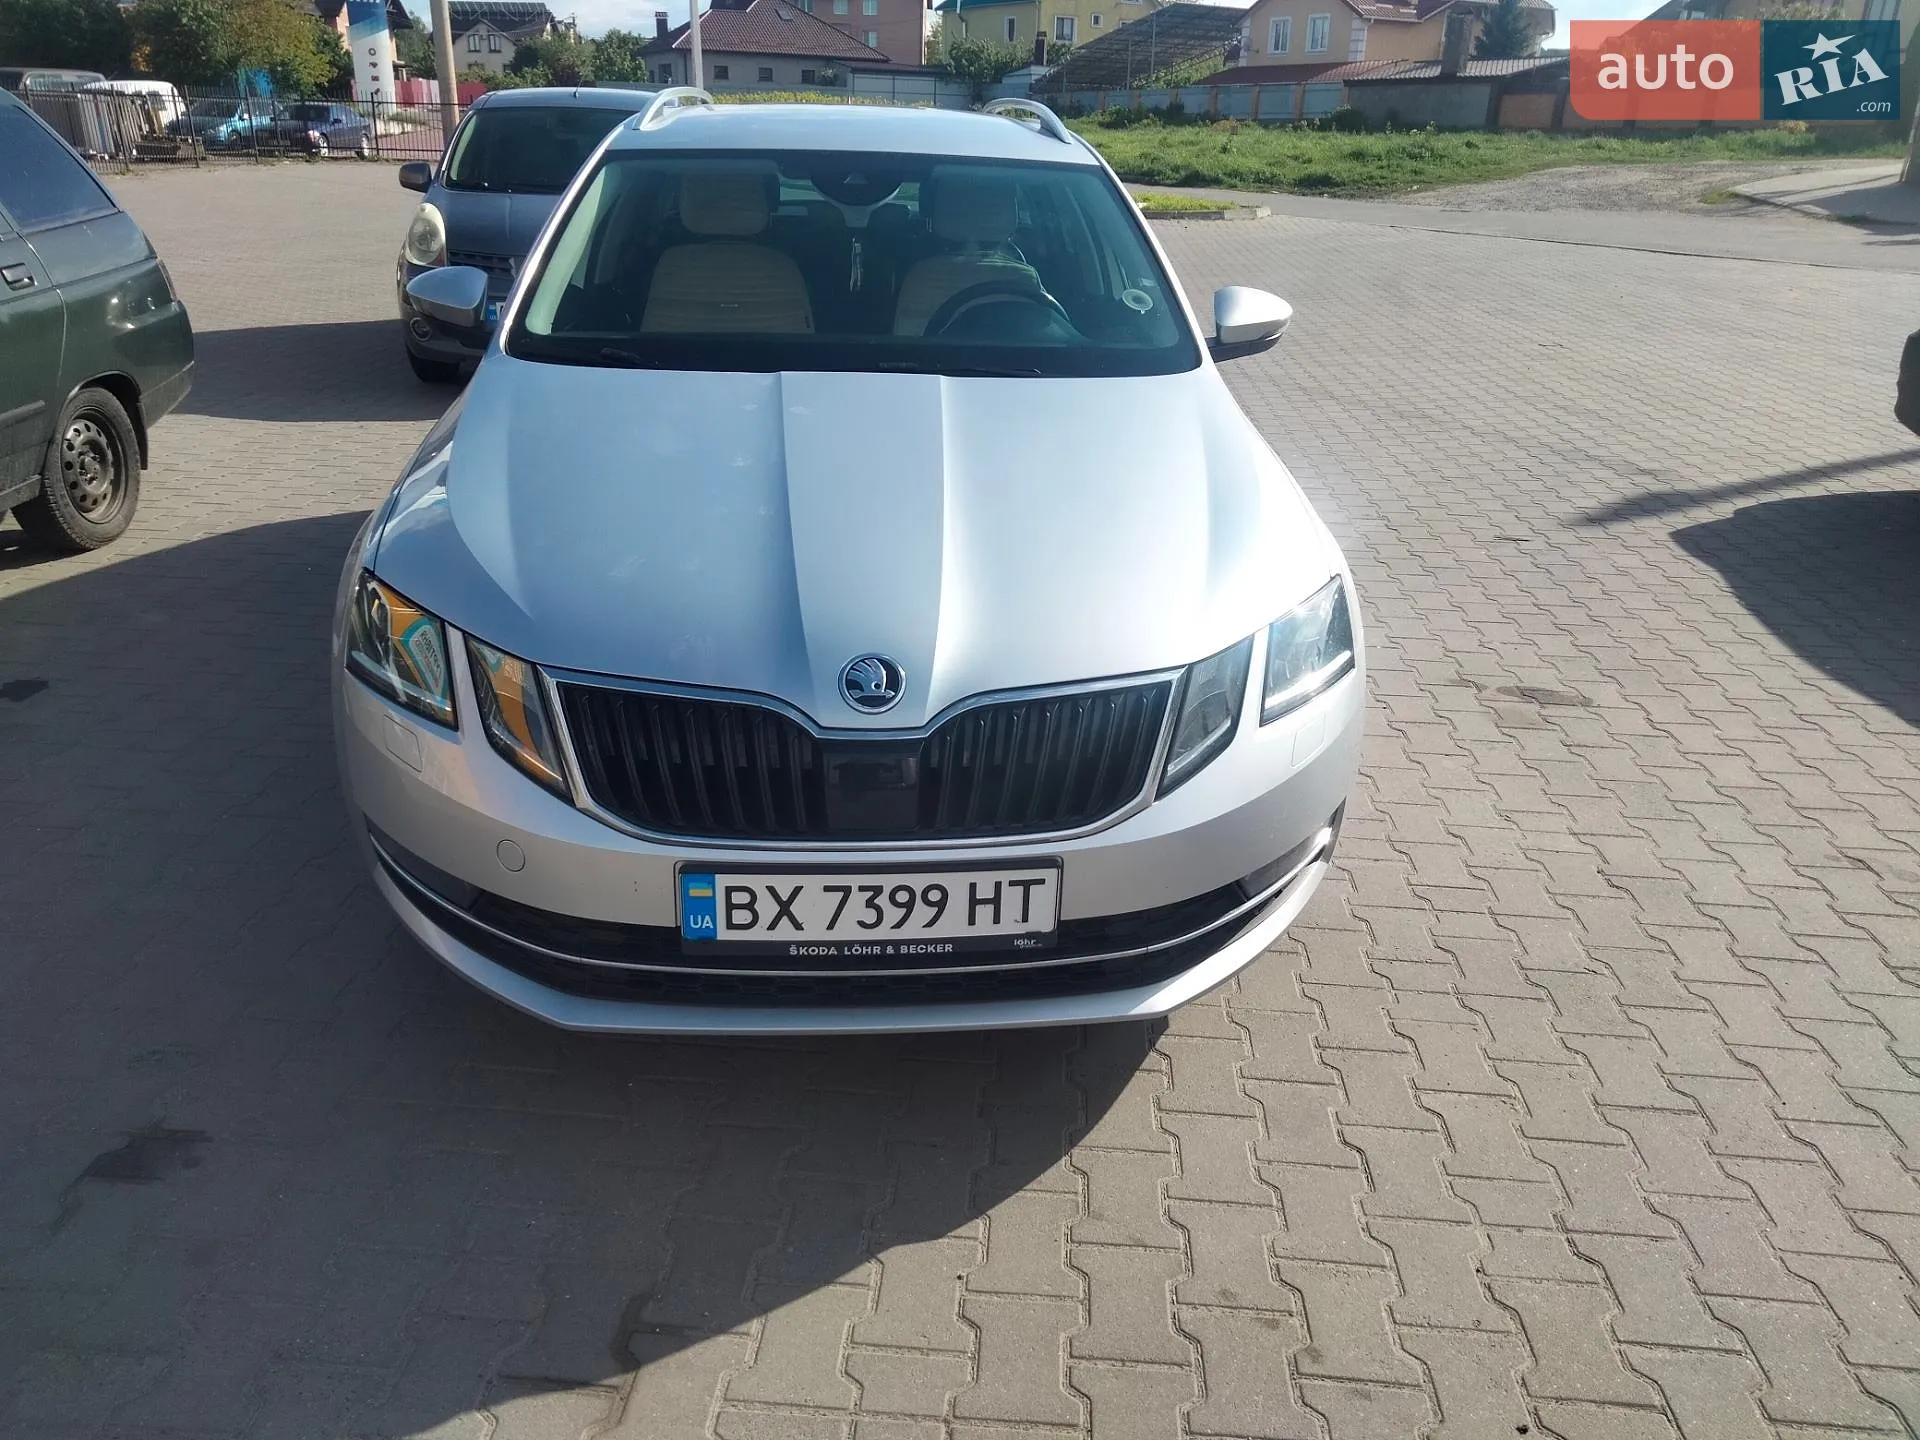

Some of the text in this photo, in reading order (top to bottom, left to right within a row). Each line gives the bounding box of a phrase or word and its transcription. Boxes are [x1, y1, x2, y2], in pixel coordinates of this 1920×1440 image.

[724, 878, 1046, 932] BX 7399 HT
[690, 914, 714, 929] UA
[789, 943, 953, 956] ŠKODA LÖHR & BECKER
